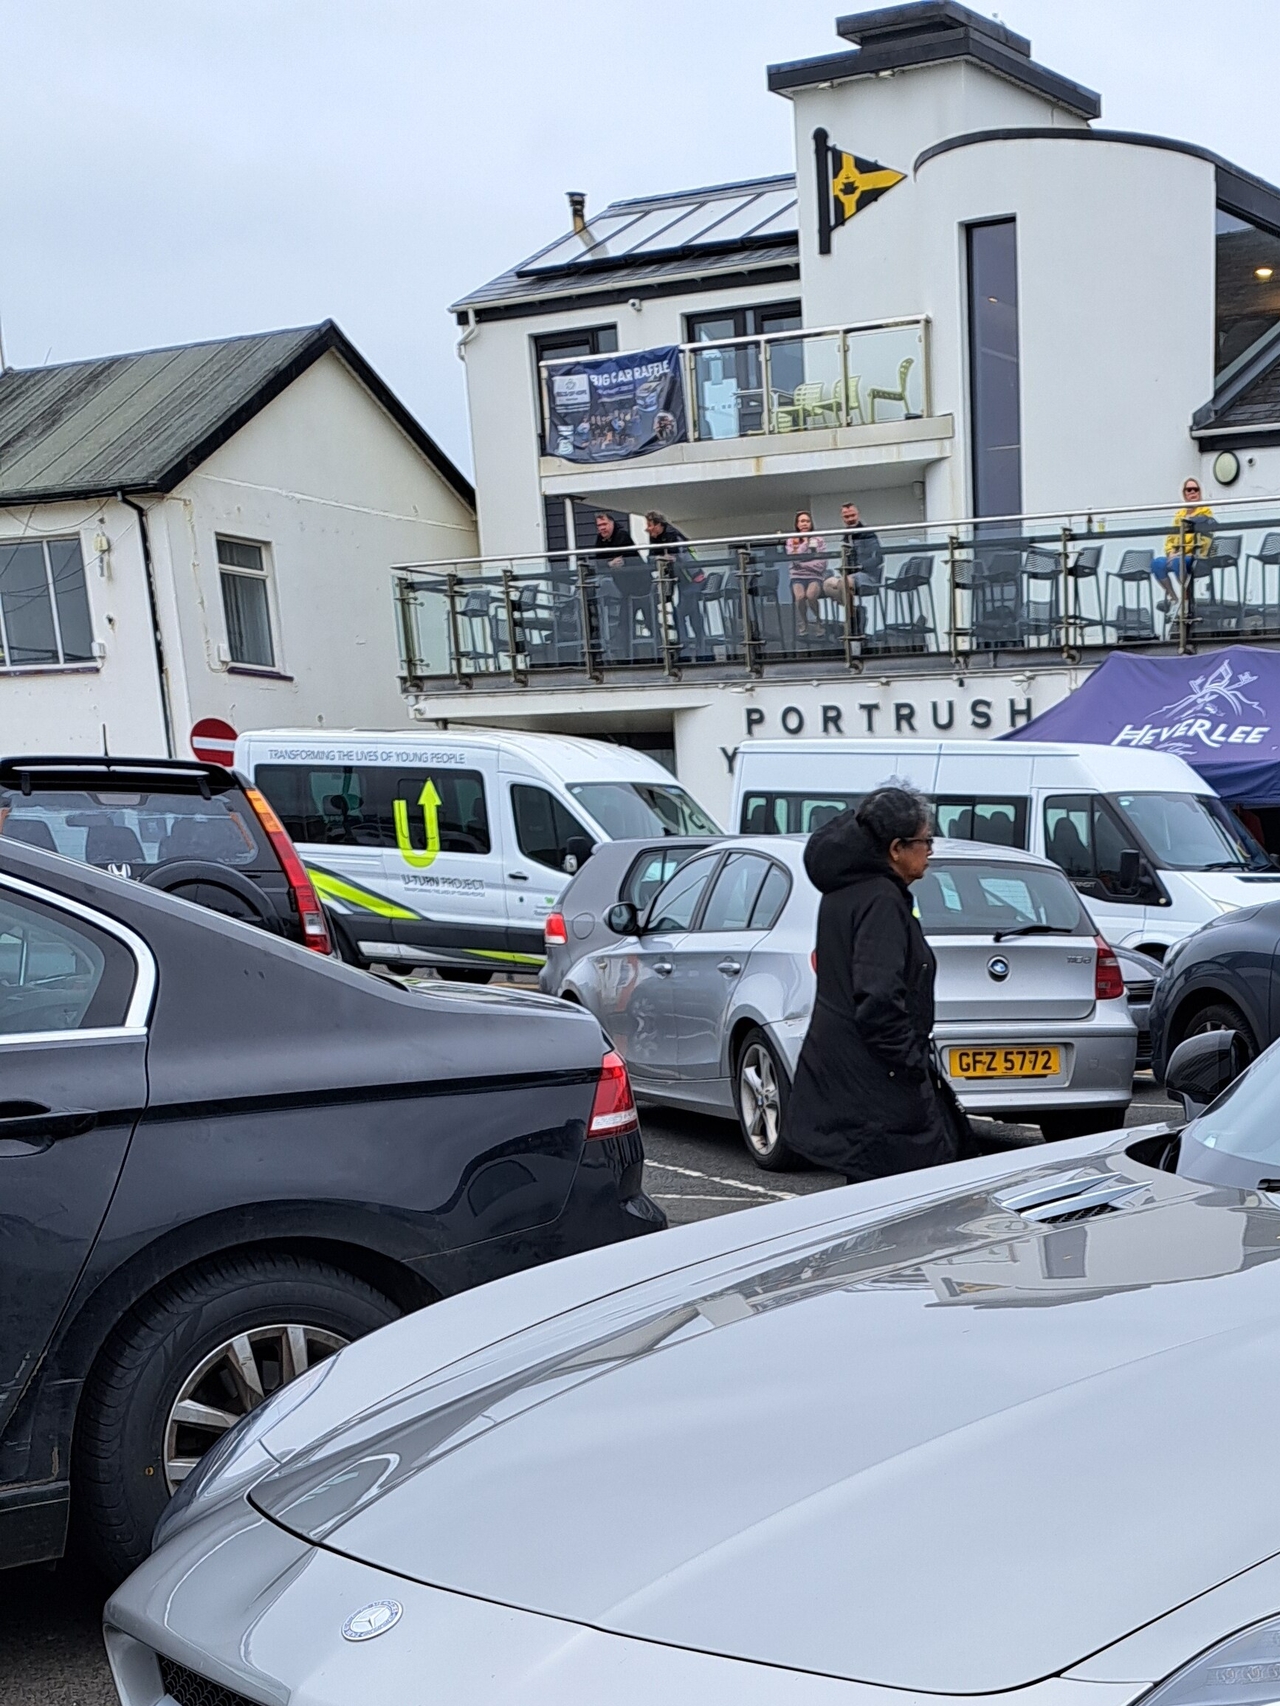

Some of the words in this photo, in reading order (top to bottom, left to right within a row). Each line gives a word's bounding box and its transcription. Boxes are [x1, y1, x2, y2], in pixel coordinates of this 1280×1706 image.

[589, 373, 610, 386] BIG
[611, 368, 633, 384] CAR
[633, 360, 670, 380] RAFFLE
[745, 698, 1033, 736] PORTRUSH
[1110, 718, 1271, 748] HEVERLEE
[268, 749, 336, 761] TRANSFORMING
[336, 750, 354, 761] THE
[355, 750, 379, 762] LIVES
[380, 751, 394, 762] OF
[395, 751, 429, 764] YOUNG
[429, 752, 466, 765] PEOPLE
[401, 873, 440, 888] U-TURN
[440, 876, 485, 891] PROJECT
[958, 1051, 997, 1073] GFZ
[1003, 1050, 1053, 1072] 5772
